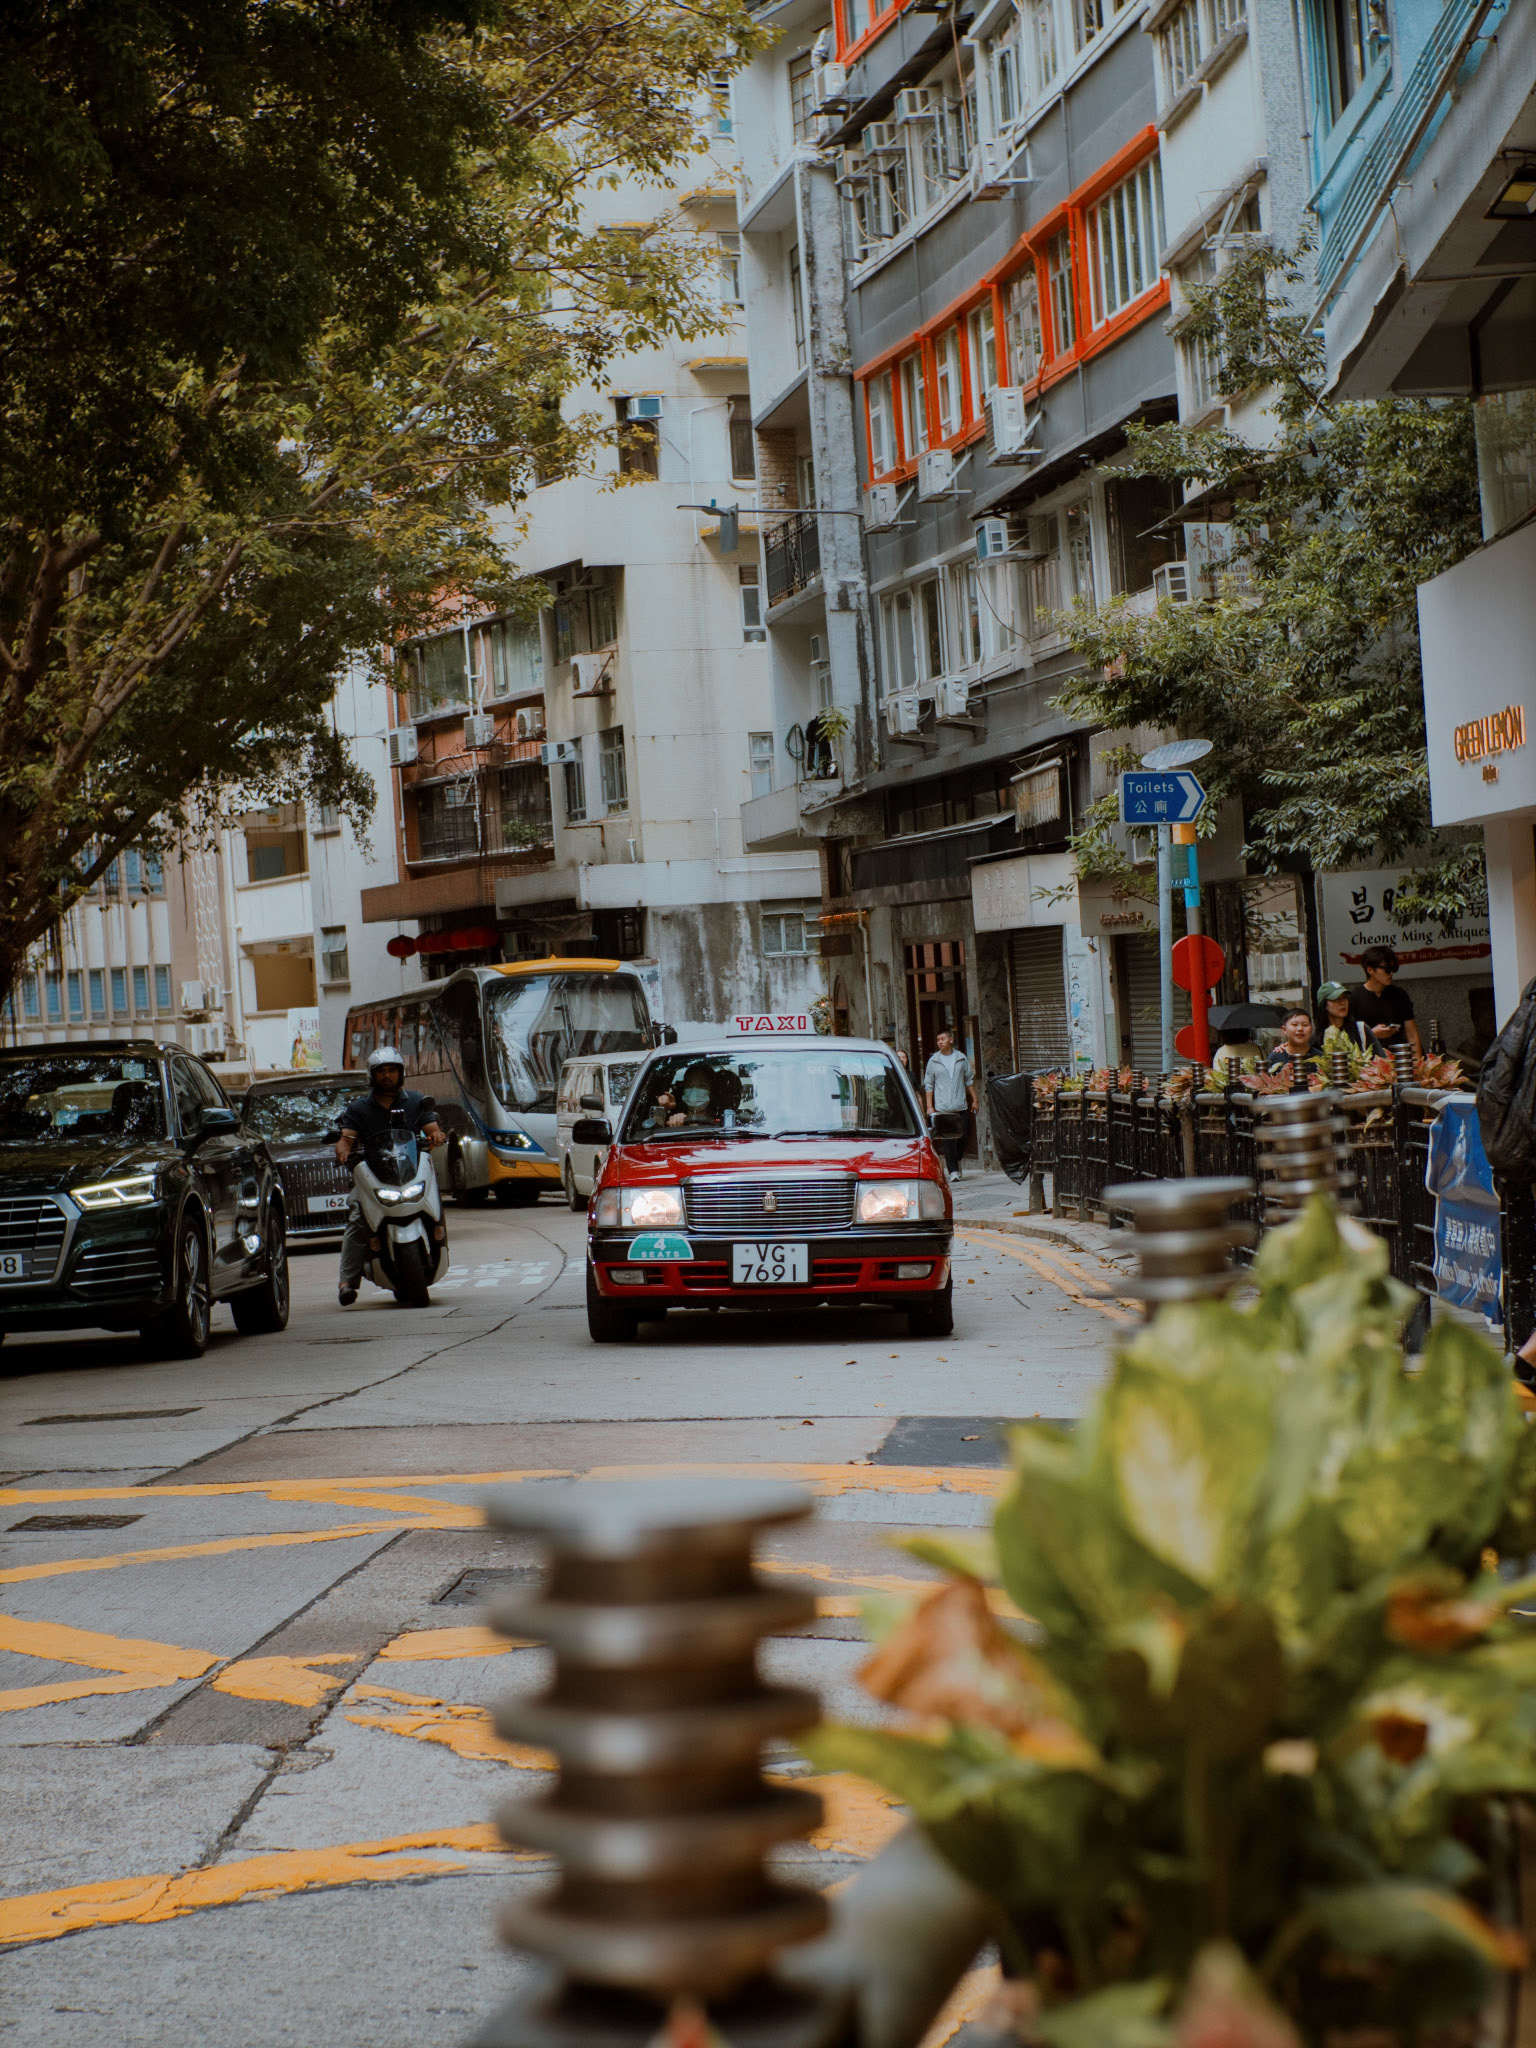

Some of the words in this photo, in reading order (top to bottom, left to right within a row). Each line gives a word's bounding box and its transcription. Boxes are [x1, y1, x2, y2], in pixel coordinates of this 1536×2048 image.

[1454, 717, 1488, 761] GREEN
[1488, 706, 1526, 752] LEMON
[1127, 782, 1175, 793] Toilets
[1135, 800, 1168, 814] 公廁
[1351, 931, 1397, 947] Cheong
[1401, 929, 1433, 944] Ming
[1437, 926, 1490, 942] Antiques
[736, 1016, 806, 1031] TAXI
[653, 1238, 667, 1251] 4
[756, 1243, 785, 1262] VG
[0, 1256, 17, 1274] 8
[740, 1264, 797, 1282] 7691
